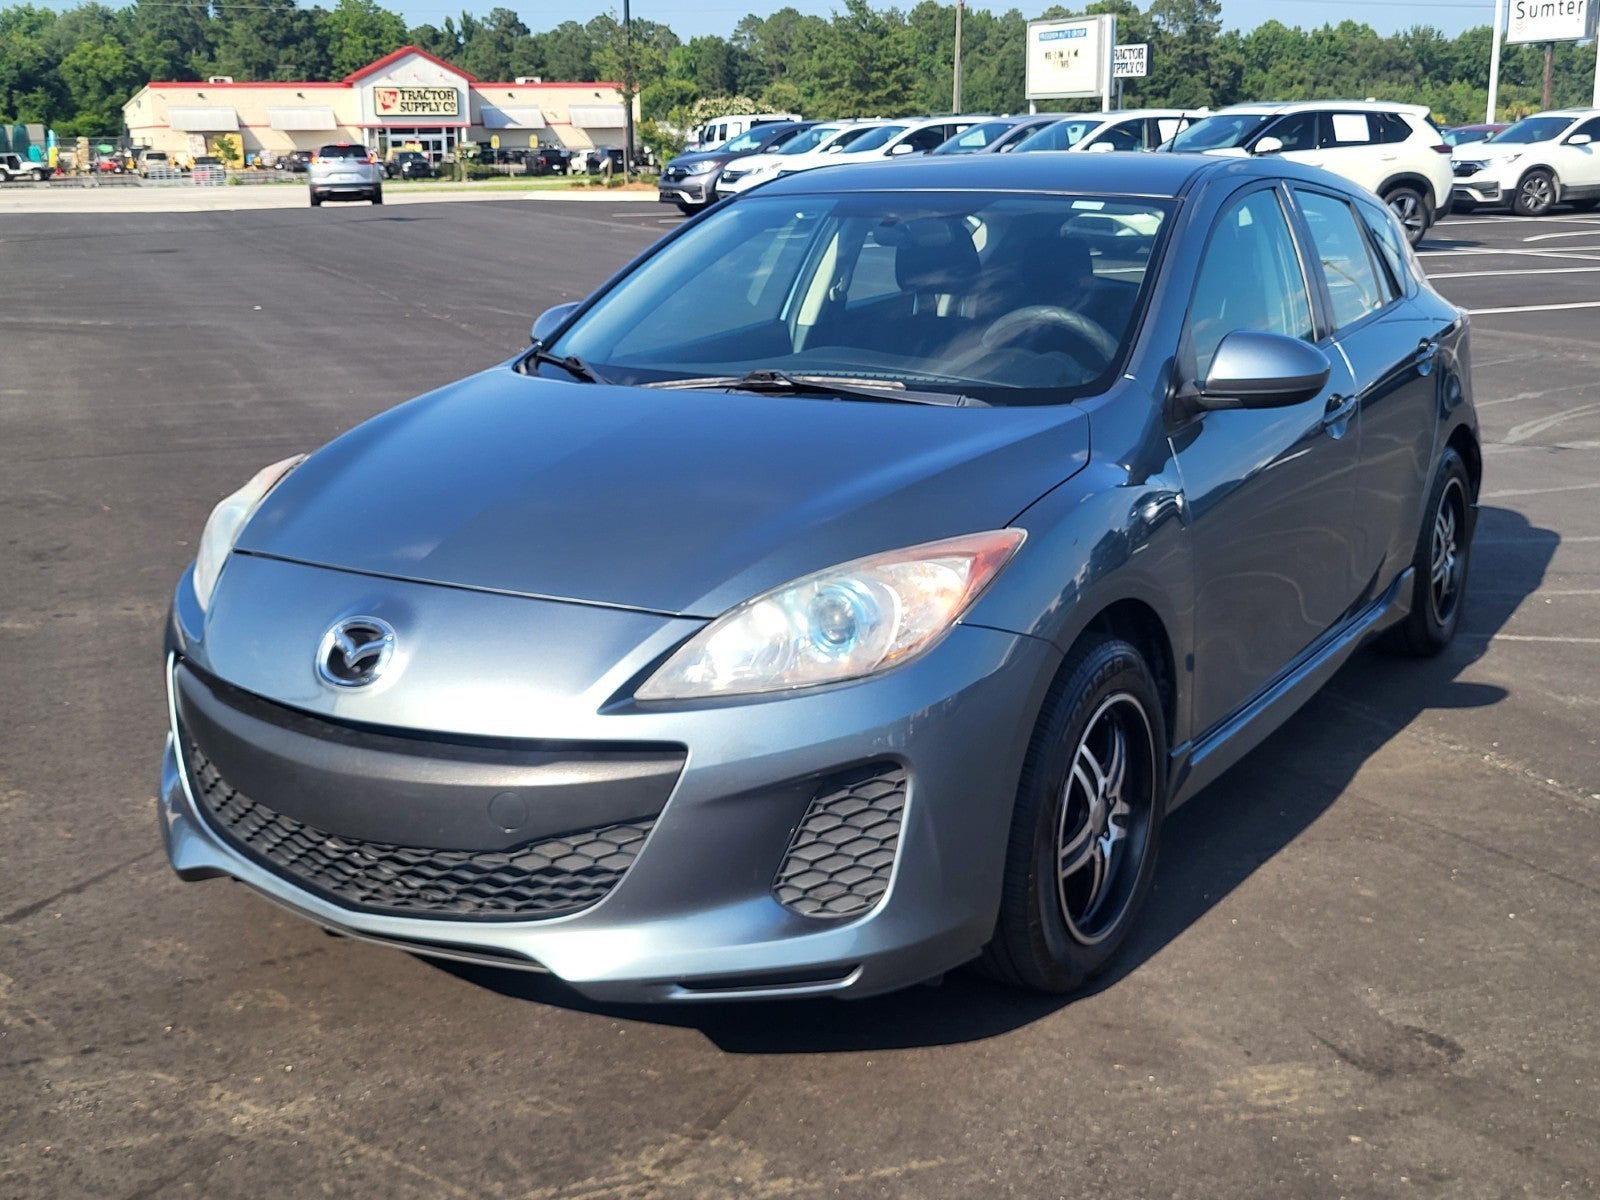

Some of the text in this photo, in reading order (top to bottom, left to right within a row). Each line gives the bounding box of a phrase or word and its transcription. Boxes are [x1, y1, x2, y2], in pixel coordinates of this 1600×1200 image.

[1516, 0, 1583, 20] Sumter
[1114, 48, 1144, 60] RACTOR
[400, 90, 455, 101] TRACTOR
[400, 101, 441, 112] SUPPLY
